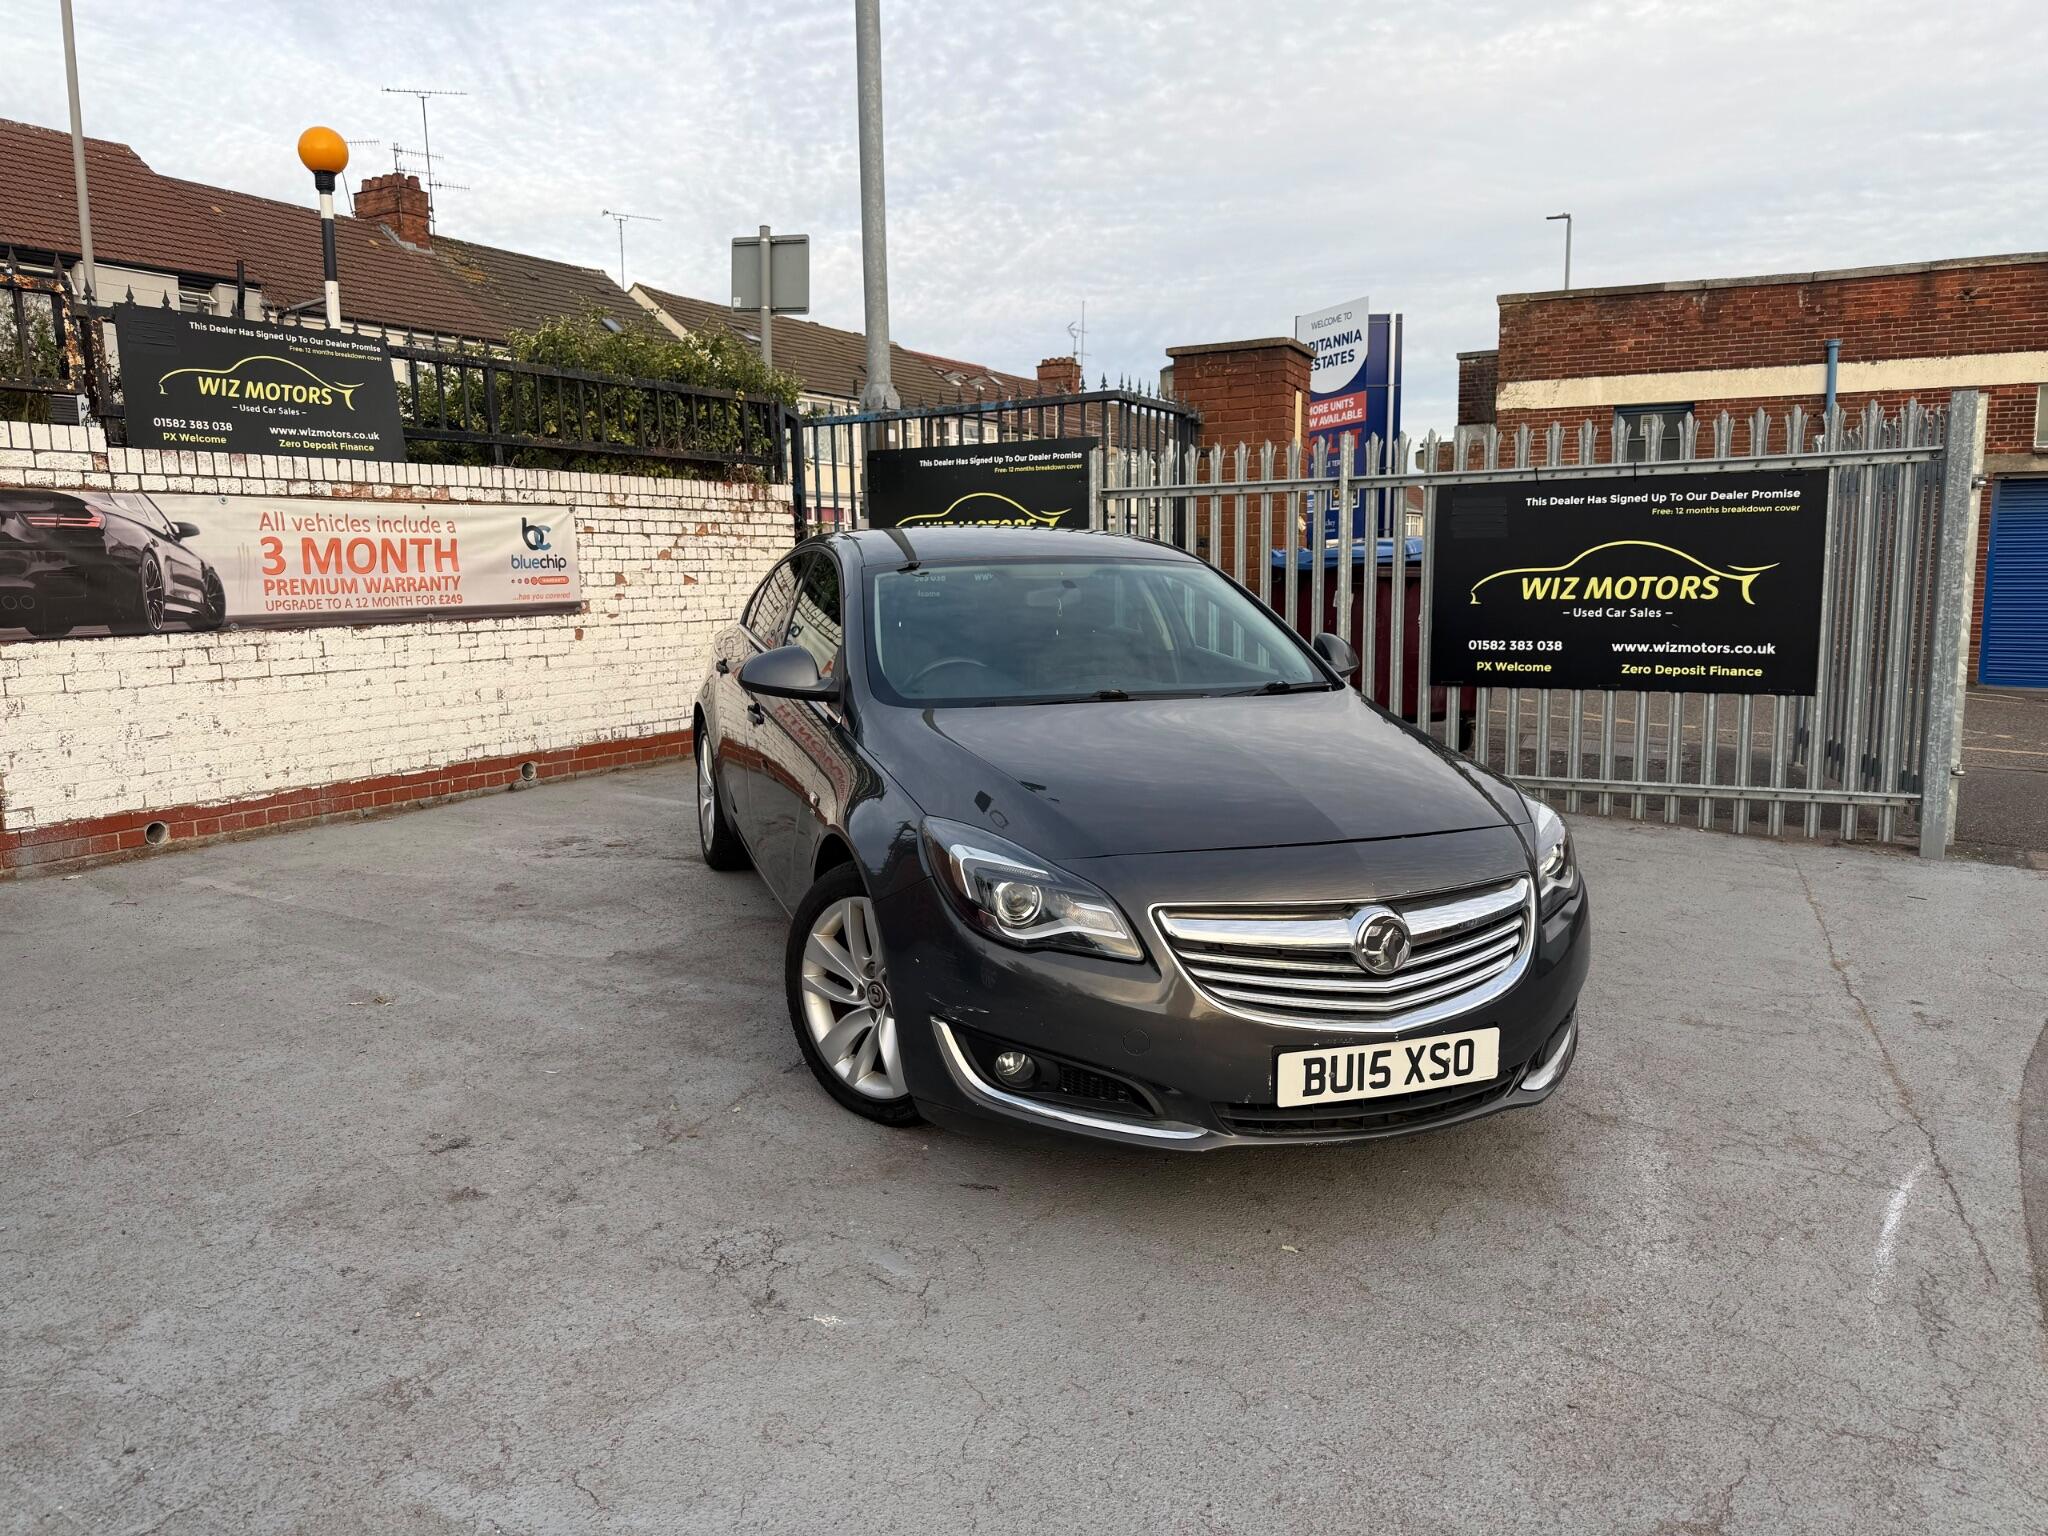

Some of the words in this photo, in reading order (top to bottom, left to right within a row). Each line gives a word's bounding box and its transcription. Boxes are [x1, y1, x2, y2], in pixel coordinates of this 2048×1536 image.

[1311, 314, 1342, 330] WELCOME
[1344, 312, 1353, 321] TO
[189, 321, 207, 331] This
[210, 324, 237, 335] Dealer
[239, 327, 254, 337] Has
[256, 330, 284, 341] Signed
[286, 334, 297, 343] Up
[299, 335, 308, 344] To
[310, 337, 324, 346] Our
[326, 339, 350, 349] Dealer
[351, 342, 381, 353] Promise
[1304, 329, 1363, 352] RITANNIA
[312, 348, 334, 357] months
[334, 350, 366, 360] breakdown
[198, 376, 240, 399] WIZ
[245, 381, 333, 406] MOTORS
[239, 403, 260, 414] Used
[263, 405, 277, 415] Car
[278, 407, 300, 416] Sales
[1329, 397, 1354, 412] UNITS
[153, 418, 187, 429] 01582
[189, 419, 210, 430] 383
[212, 421, 233, 432] 038
[1319, 409, 1363, 426] AVAILABLE
[163, 432, 177, 442] PX
[179, 433, 227, 444] Welcome
[269, 426, 380, 441] www.wizmotors.co.uk
[279, 439, 301, 449] Zero
[303, 440, 338, 451] Deposit
[341, 442, 375, 452] Finance
[919, 459, 933, 468] This
[933, 458, 955, 468] Dealer
[955, 457, 969, 466] Has
[969, 456, 993, 467] Signed
[994, 455, 1004, 464] Up
[1005, 455, 1013, 463] To
[1014, 454, 1027, 463] Our
[1028, 453, 1051, 462] Dealer
[1052, 451, 1083, 461] Promise
[1014, 465, 1035, 473] months
[1035, 464, 1066, 472] breakdown
[1526, 497, 1548, 506] This
[1550, 495, 1585, 506] Dealer
[1587, 494, 1607, 504] Has
[1609, 492, 1648, 506] Signed
[1651, 492, 1668, 504] Up
[1670, 492, 1684, 502] To
[1686, 491, 1708, 501] Our
[1711, 489, 1748, 501] Dealer
[1750, 488, 1801, 500] Promise
[1686, 506, 1720, 514] months
[1721, 504, 1773, 513] breakdown
[1774, 505, 1801, 513] cover
[259, 511, 285, 531] All
[291, 513, 371, 533] vehicles
[376, 515, 442, 534] include
[446, 521, 456, 534] a
[260, 536, 287, 575] 3
[301, 537, 460, 575] MONTH
[511, 554, 567, 572] bluechip
[264, 577, 359, 596] PREMIUM
[362, 575, 461, 594] WARRANTY
[1521, 577, 1582, 600] WIZ
[1584, 575, 1721, 600] MOTORS
[265, 598, 323, 611] UPGRADE
[325, 598, 342, 610] TO
[344, 598, 356, 609] A
[356, 598, 369, 609] 12
[372, 595, 413, 608] MONTH
[416, 595, 437, 606] FOR
[438, 594, 463, 605] £249
[532, 593, 544, 602] you
[545, 592, 571, 600] covered
[1573, 607, 1602, 618] Used
[1605, 608, 1628, 618] Car
[1630, 607, 1662, 618] Sales
[1468, 639, 1506, 651] 01582
[1509, 640, 1535, 652] 383
[1537, 640, 1563, 652] 038
[1611, 641, 1776, 655] www.wizmotors.co.uk
[1477, 662, 1492, 672] PX
[1495, 661, 1552, 673] Welcome
[1621, 664, 1652, 675] Zero
[1654, 664, 1706, 678] Deposit
[1709, 665, 1763, 677] Finance
[1303, 1049, 1392, 1098] BU15
[1404, 1038, 1475, 1086] XSO
